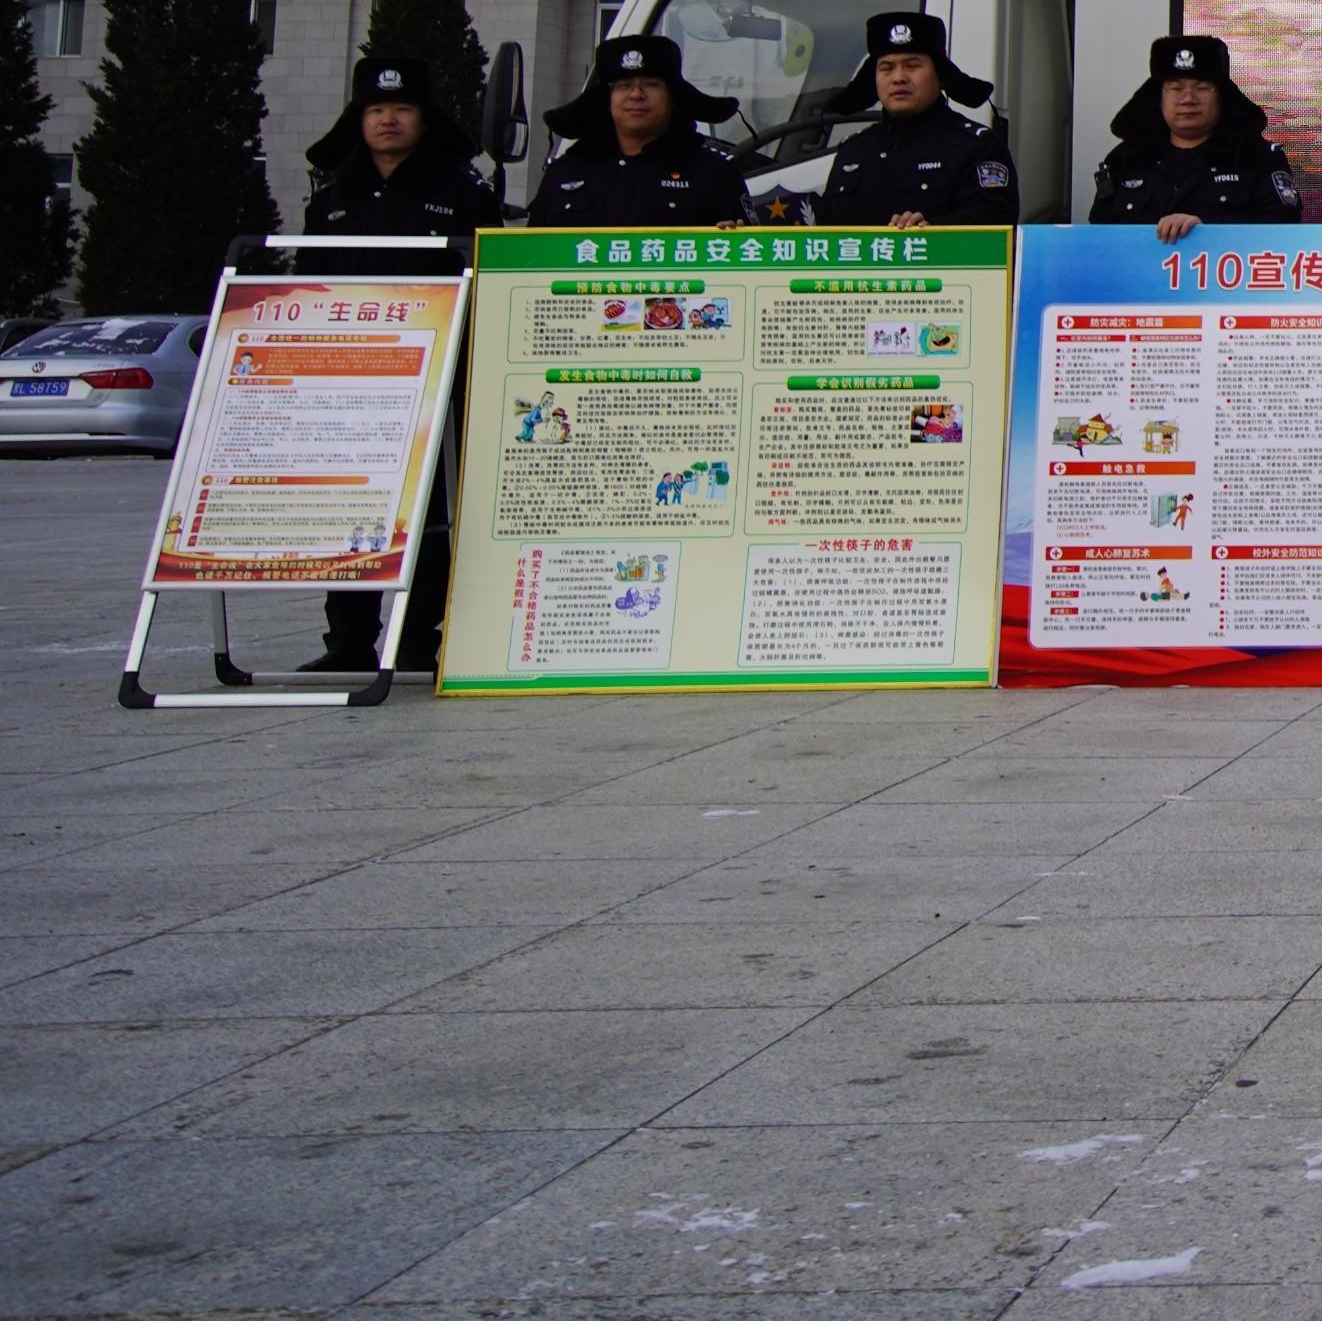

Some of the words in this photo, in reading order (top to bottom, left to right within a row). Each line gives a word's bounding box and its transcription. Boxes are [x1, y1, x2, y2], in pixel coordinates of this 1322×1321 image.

[575, 237, 929, 263] 食品药品安全知识宣传栏
[576, 282, 690, 294] 预防食物中毒要点
[559, 369, 694, 382] 发生食物中毒时如何自救
[815, 377, 914, 390] 学会识别假劣药品
[1102, 463, 1146, 474] 触电急救
[804, 538, 914, 552] 一次性筷子的危害
[1085, 548, 1150, 559] 成人心肺复苏术
[512, 557, 528, 609] 什么是假药
[520, 549, 543, 663] 购买了不合格药品怎么办
